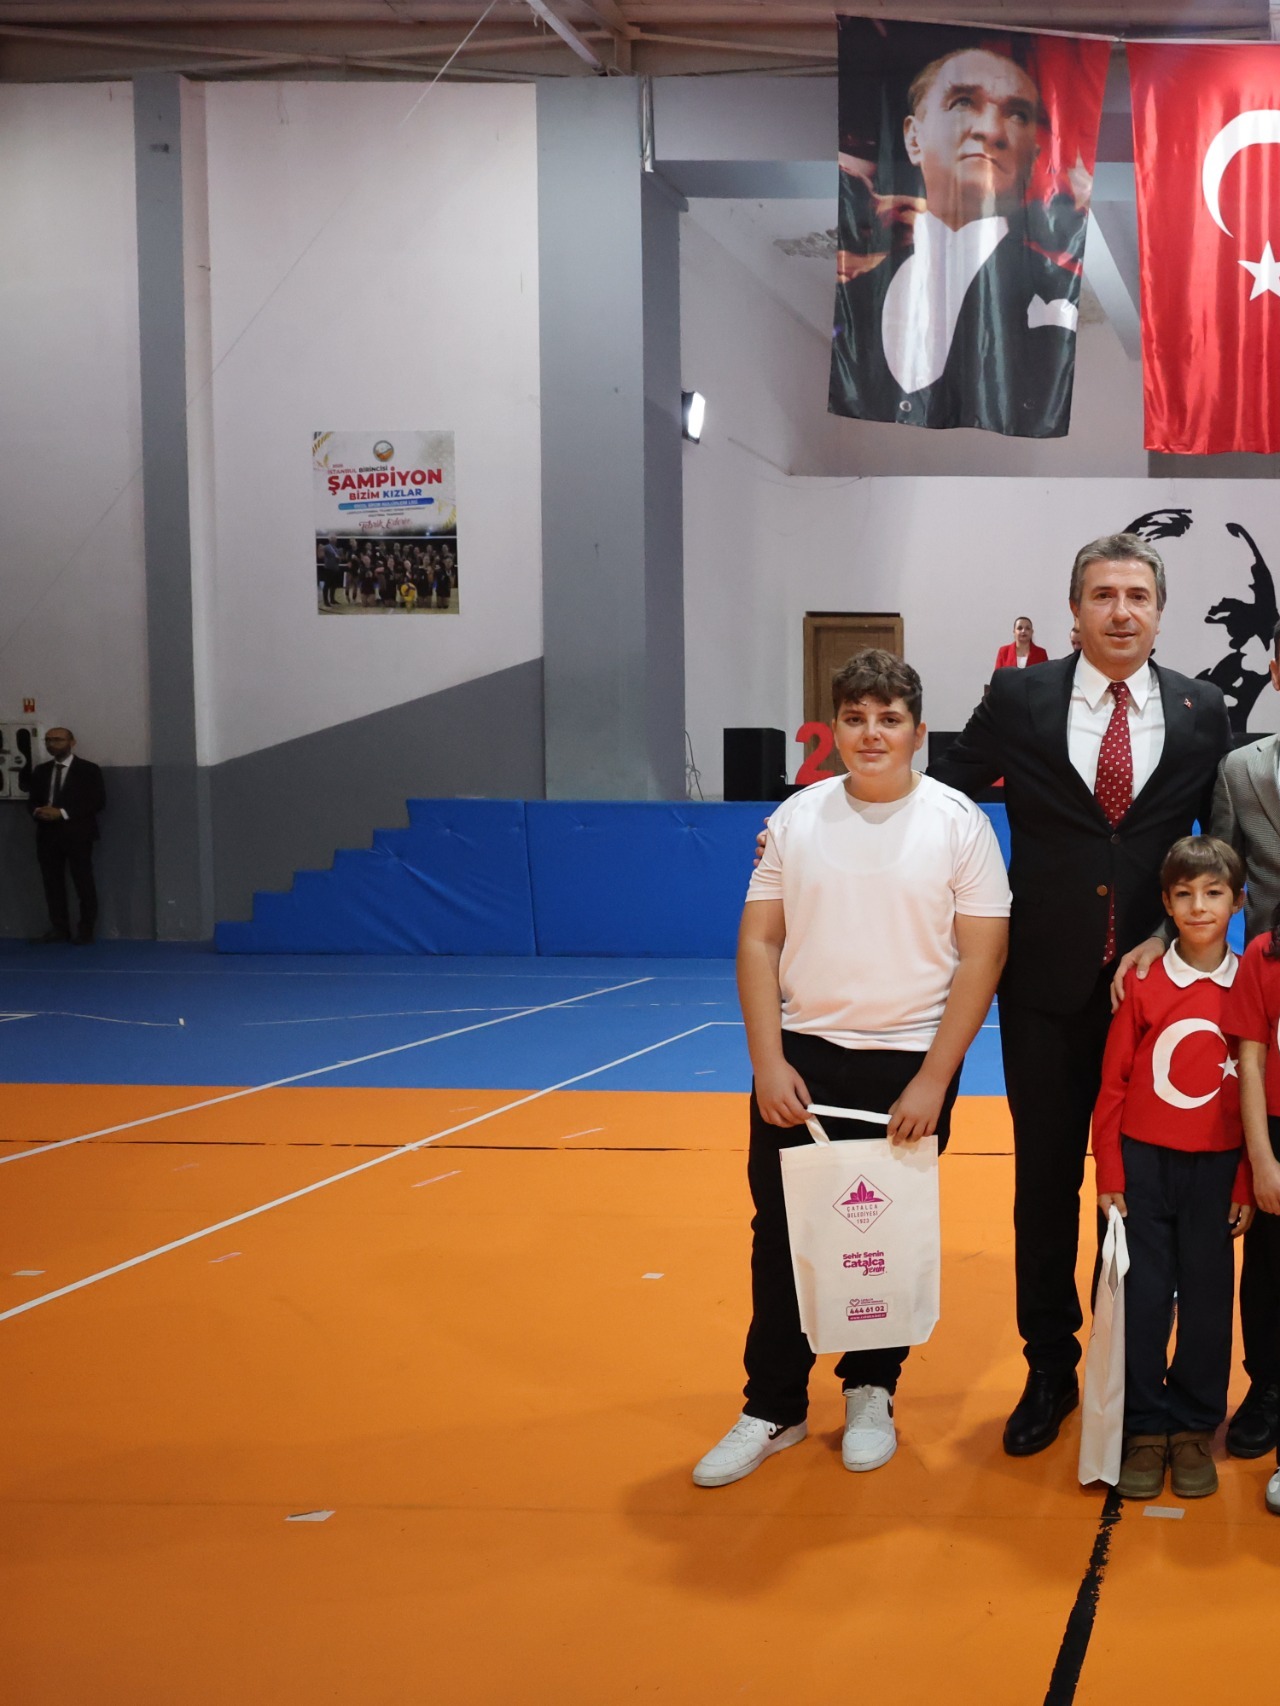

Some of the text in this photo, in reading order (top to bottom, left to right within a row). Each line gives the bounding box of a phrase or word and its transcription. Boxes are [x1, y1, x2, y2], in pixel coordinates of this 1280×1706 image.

[327, 466, 443, 496] ŞAMPİYON
[349, 488, 422, 501] BİZİM KIZLAR
